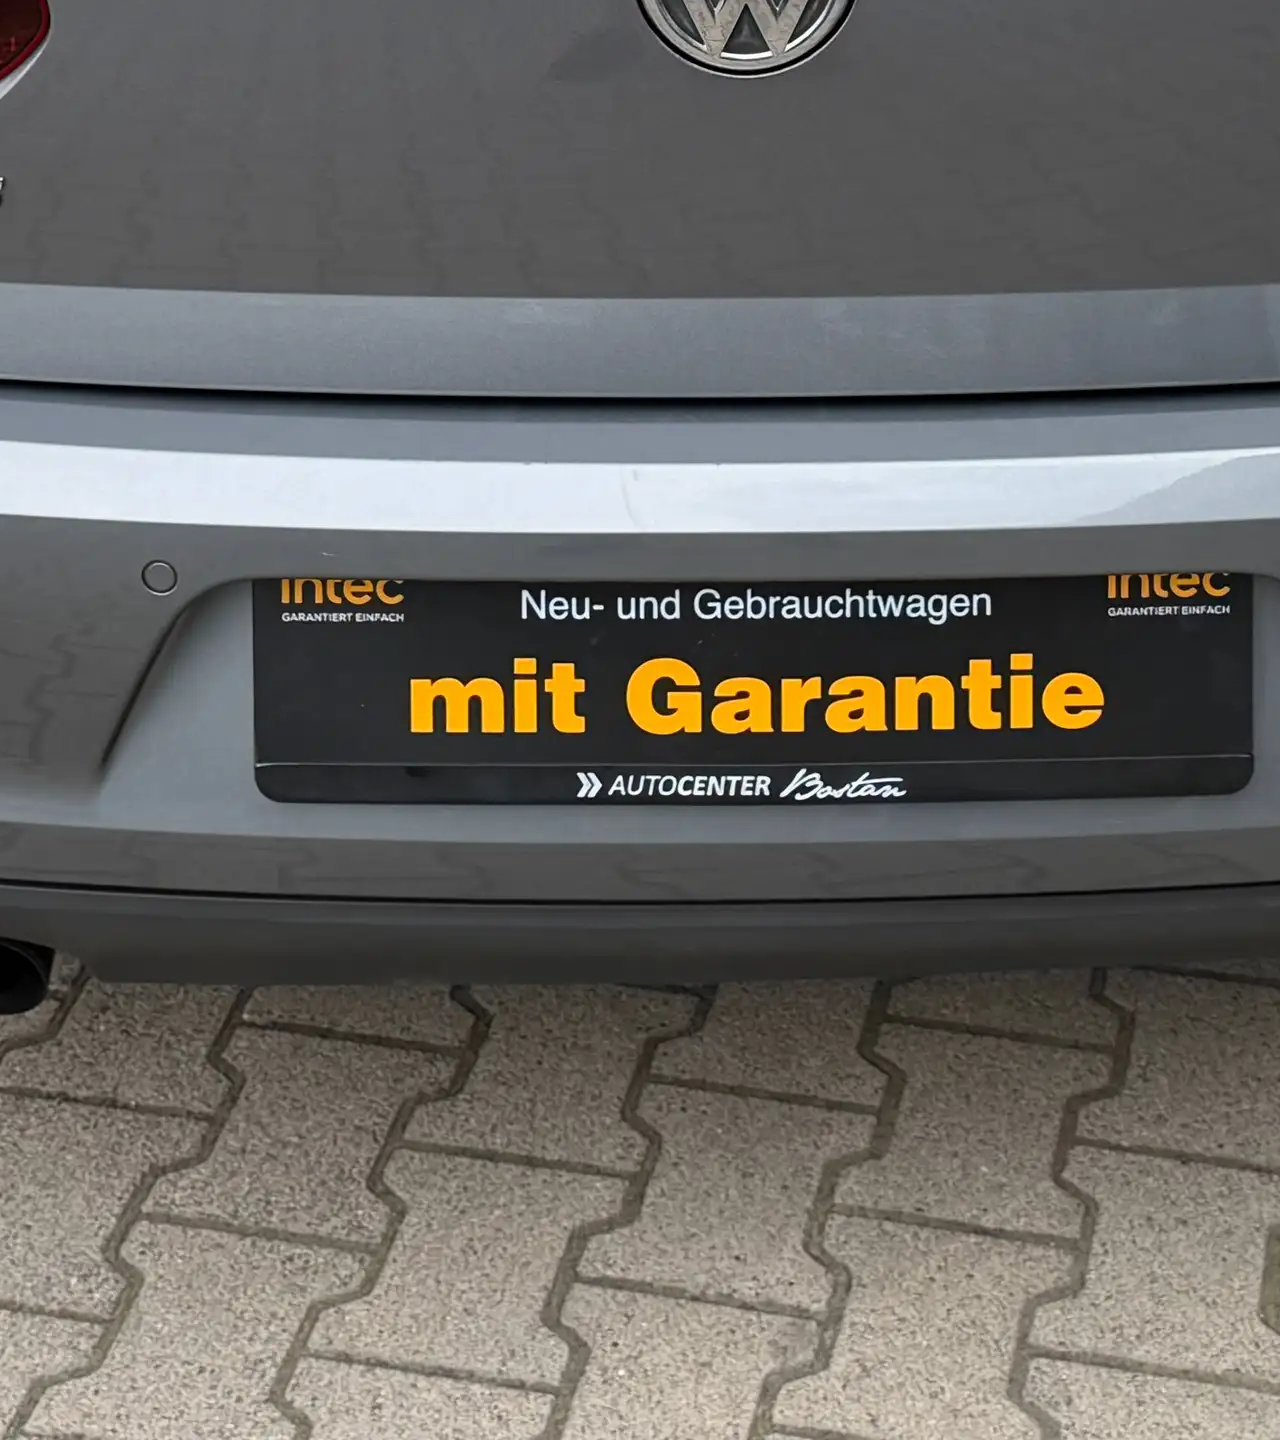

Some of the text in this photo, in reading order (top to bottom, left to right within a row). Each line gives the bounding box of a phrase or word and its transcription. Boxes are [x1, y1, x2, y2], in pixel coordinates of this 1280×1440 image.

[281, 612, 404, 622] GARANTIERT EINFACH
[521, 589, 992, 625] Neu- und Gebrauchtwagen
[1107, 604, 1231, 616] GARANTIERT EINFACH
[410, 653, 1105, 735] mit Garantie
[608, 767, 907, 800] AUTOCENTER Bostan
